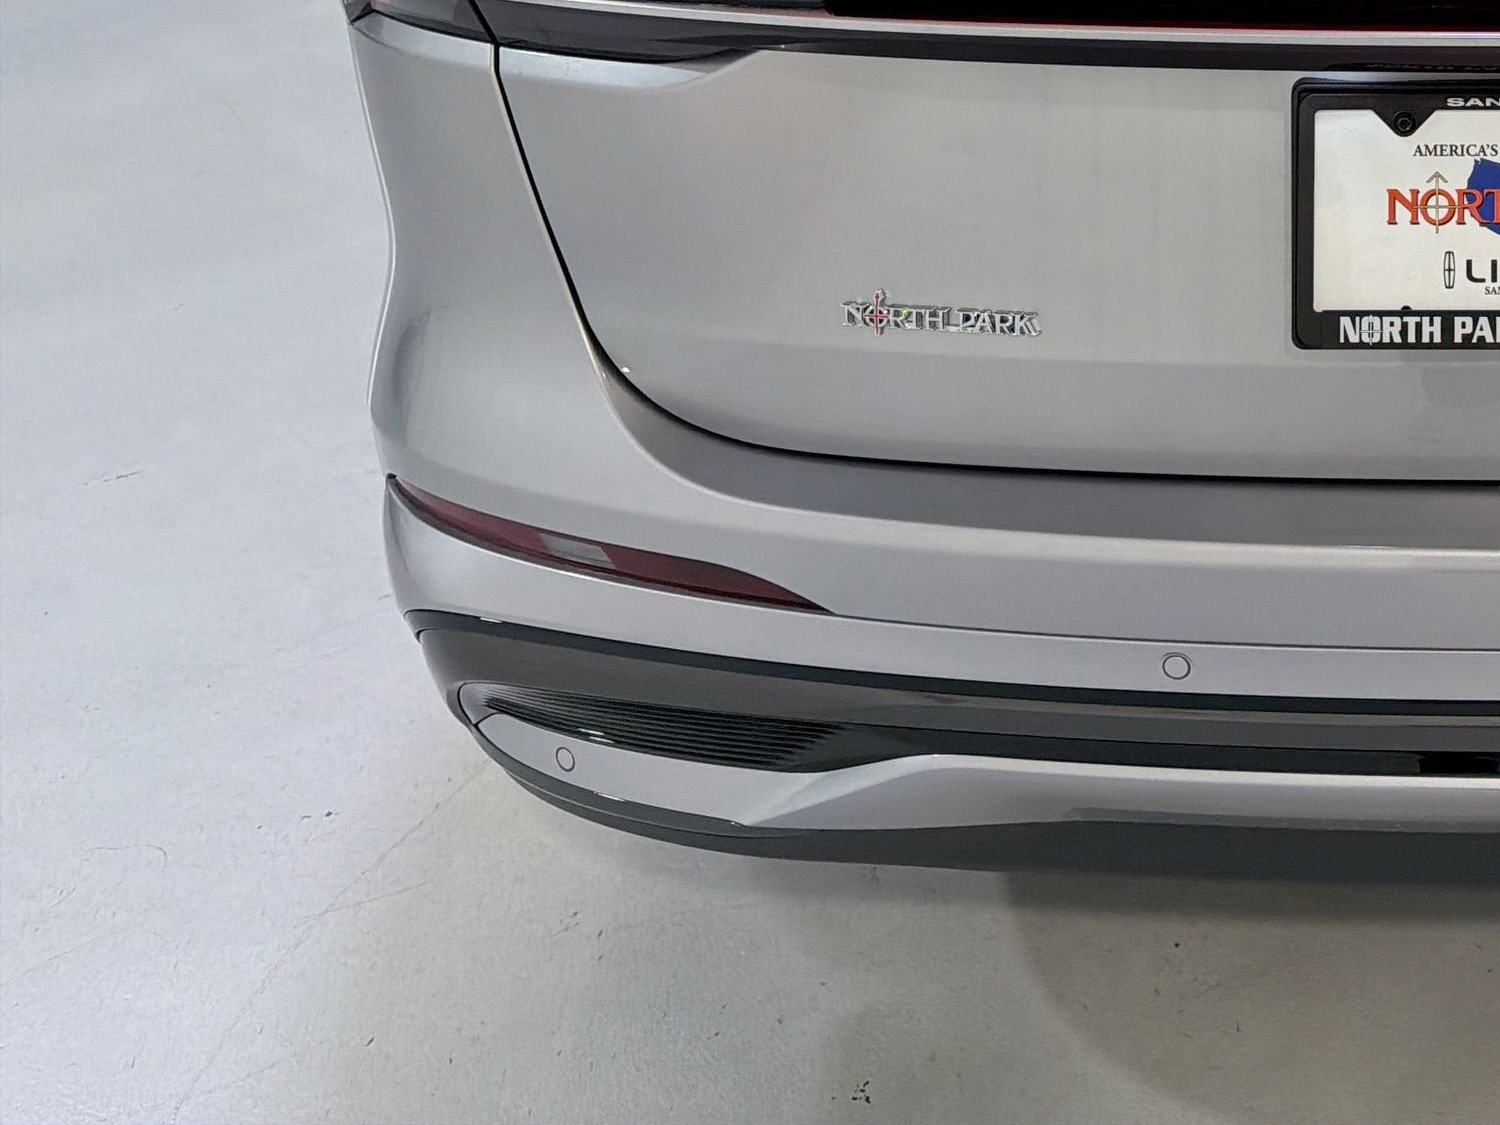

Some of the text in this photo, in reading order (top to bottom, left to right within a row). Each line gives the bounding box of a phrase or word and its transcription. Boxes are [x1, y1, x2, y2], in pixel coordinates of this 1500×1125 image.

[1413, 143, 1498, 157] AMERICA'S
[841, 301, 1041, 337] NORTH PARK
[1339, 316, 1442, 344] NORTH
